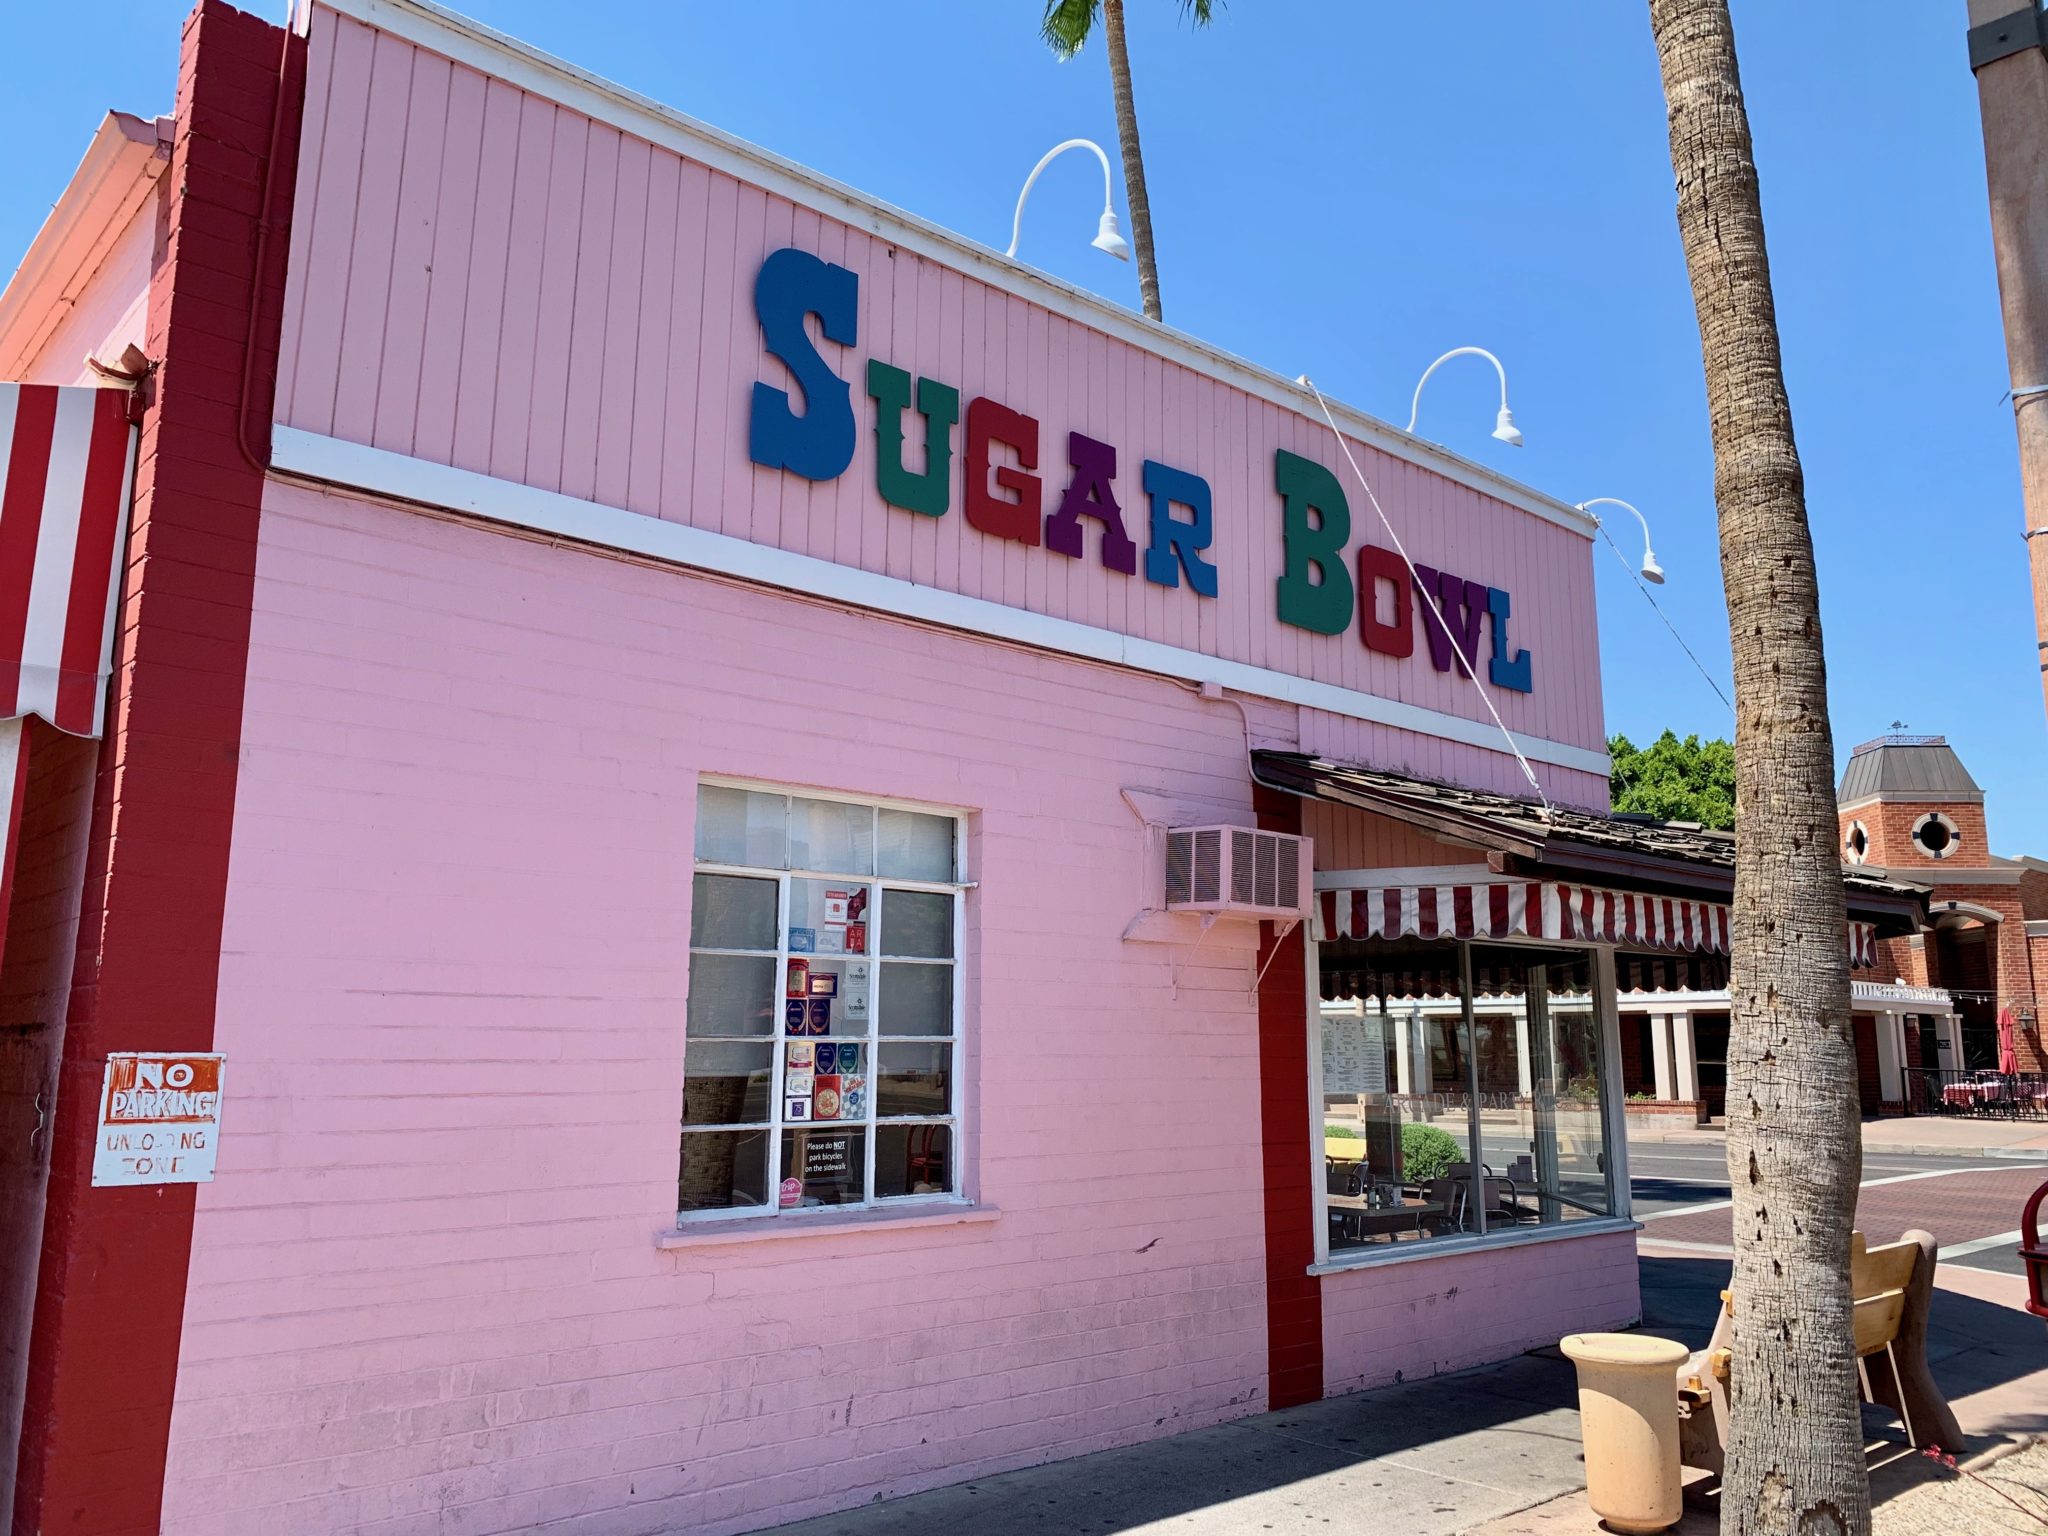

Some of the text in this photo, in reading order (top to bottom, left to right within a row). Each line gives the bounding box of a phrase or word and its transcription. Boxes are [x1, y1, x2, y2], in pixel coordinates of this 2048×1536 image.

[749, 248, 1533, 693] SUGAR BOWL
[135, 1062, 194, 1089] NO
[110, 1089, 217, 1119] PARKING
[806, 1140, 845, 1150] Please do NOT
[809, 1152, 843, 1162] park bicycles
[823, 1162, 847, 1171] sidewalk
